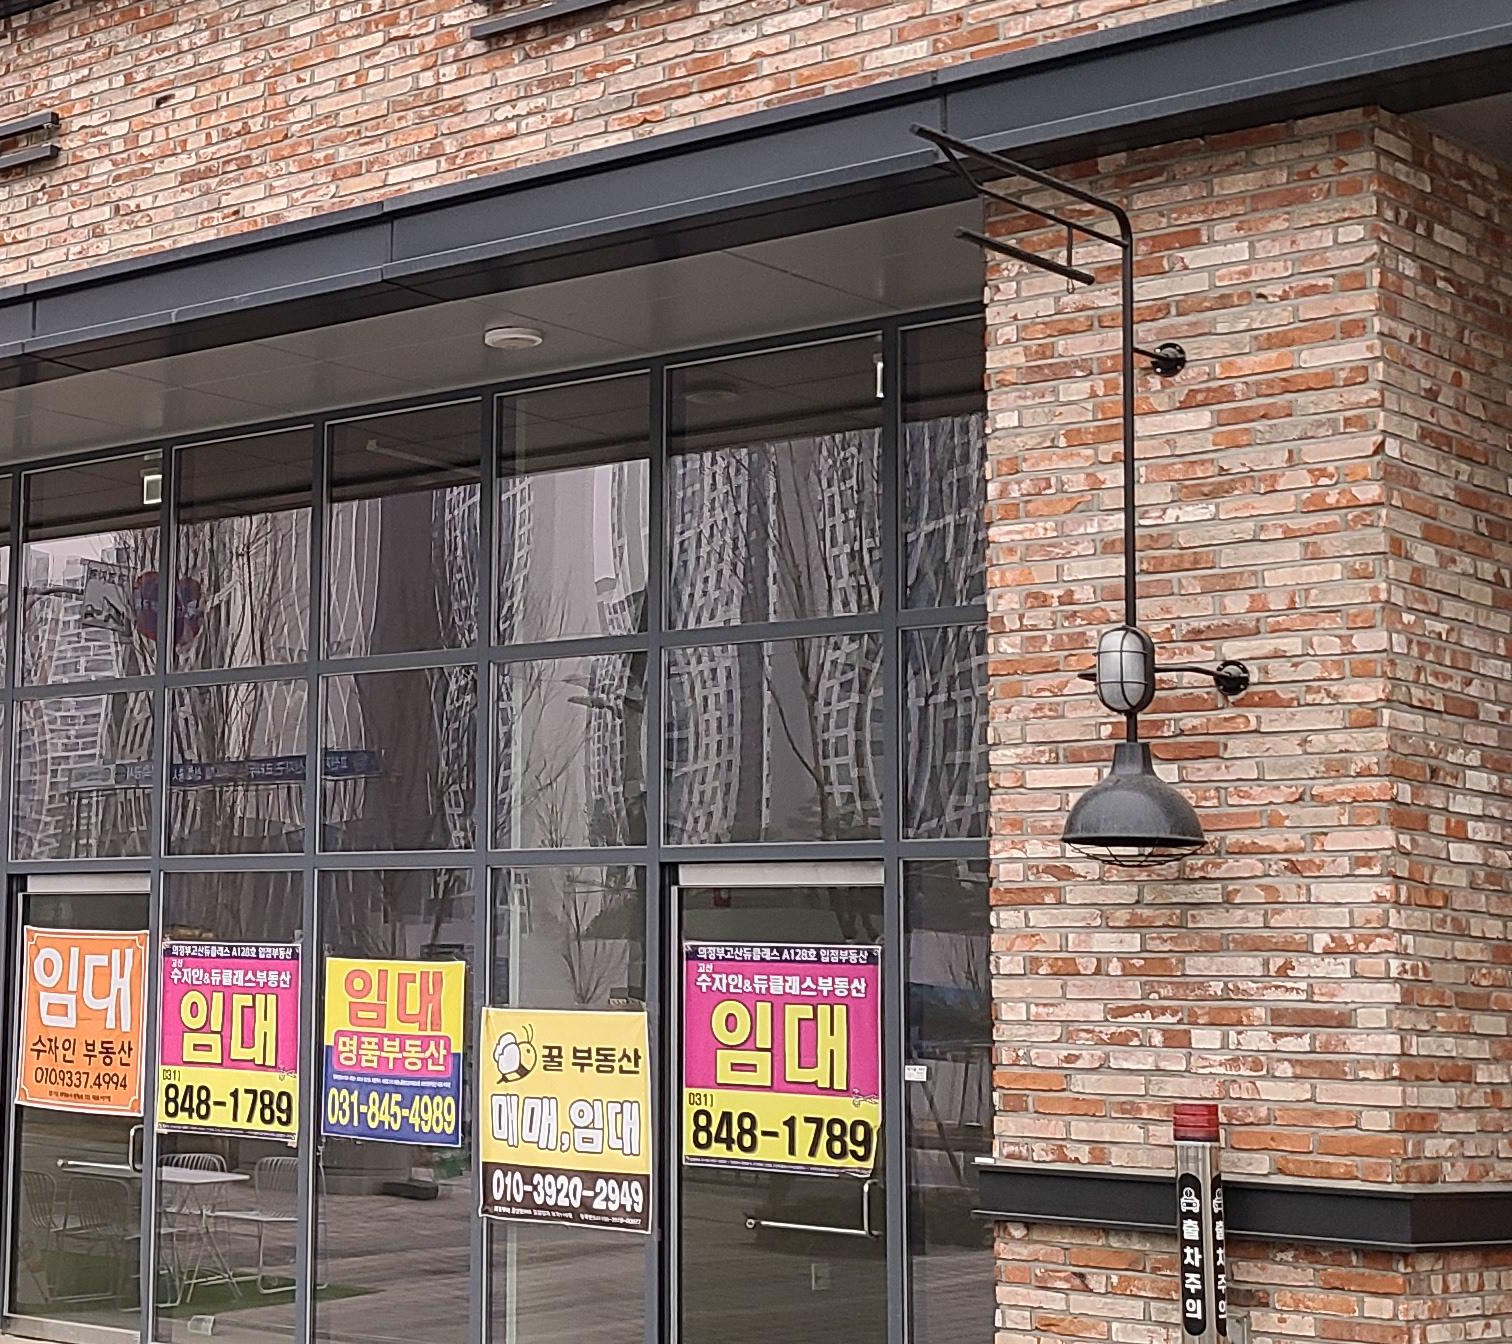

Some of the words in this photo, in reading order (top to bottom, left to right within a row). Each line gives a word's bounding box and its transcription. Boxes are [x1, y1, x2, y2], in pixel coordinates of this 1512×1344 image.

[33, 946, 134, 1033] 임대
[344, 969, 443, 1032] 임대
[695, 973, 867, 998] 수자인&듀클래스부동산
[30, 1034, 76, 1064] 수자인
[83, 1038, 134, 1067] 부동산
[180, 990, 278, 1067] 임대
[710, 999, 848, 1091] 임대
[337, 1034, 447, 1071] 명품부동산
[541, 1045, 564, 1072] 꿀
[571, 1045, 642, 1075] 부동산
[34, 1066, 128, 1091] 010.9337.4994
[688, 1092, 714, 1107] 031)
[164, 1083, 293, 1127] 848-1789
[327, 1087, 456, 1135] 031-845-4989
[491, 1093, 640, 1156] 매매,임대
[692, 1109, 873, 1162] 848-1789
[492, 1168, 643, 1213] 010-3920-2949
[1182, 1219, 1203, 1320] 출차주의
